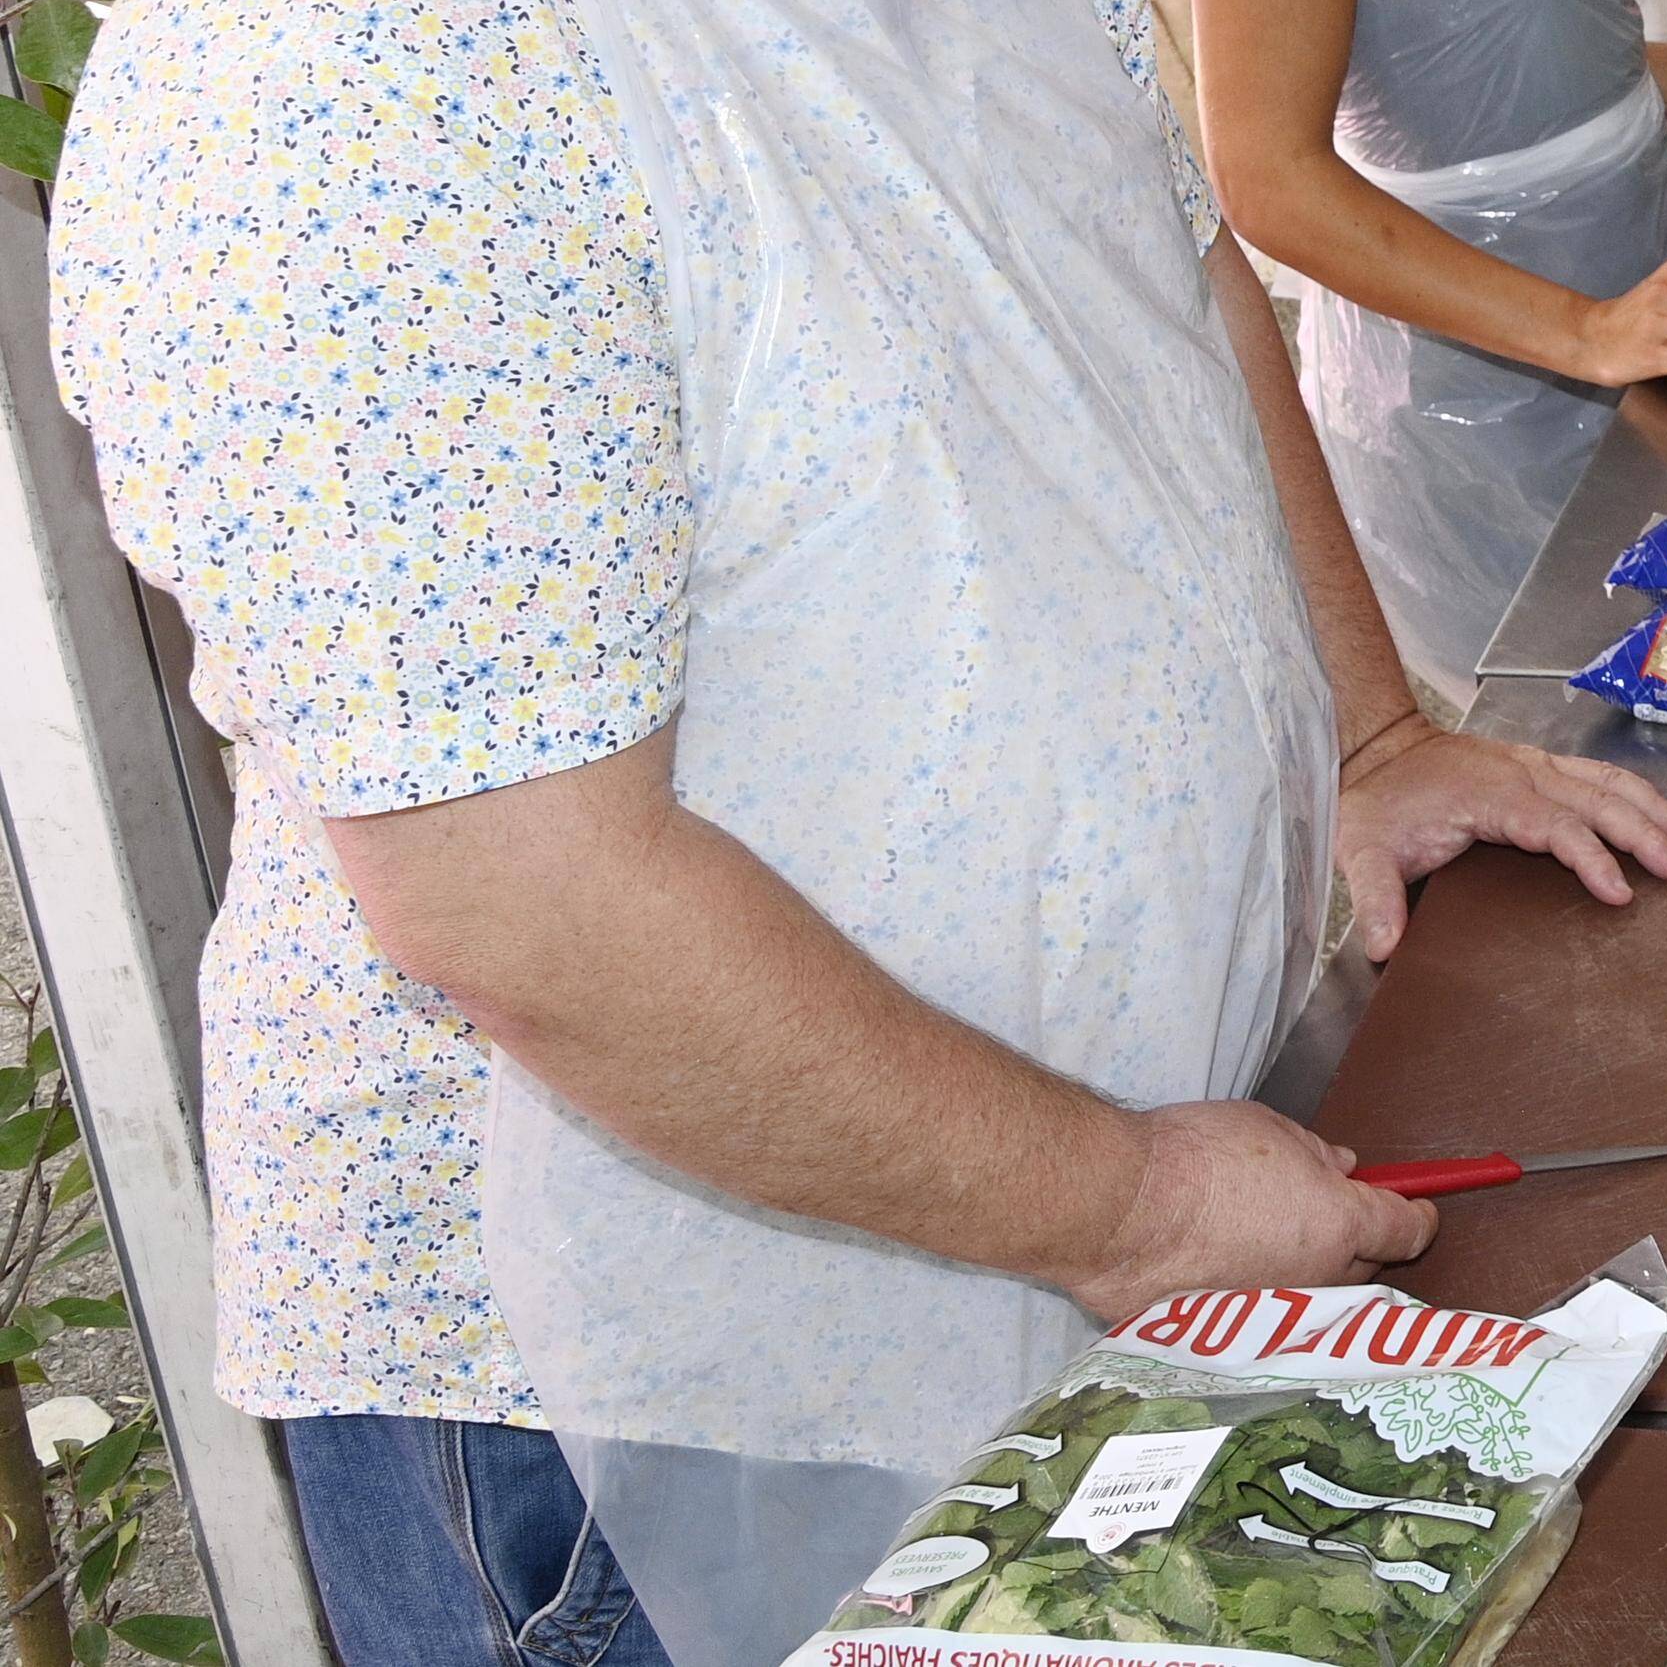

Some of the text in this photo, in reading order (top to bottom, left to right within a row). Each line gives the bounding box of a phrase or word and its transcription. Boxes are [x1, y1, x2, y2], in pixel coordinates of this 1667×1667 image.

[1288, 1467, 1358, 1505] simplement
[1089, 1499, 1160, 1518] MENTHE
[1388, 1565, 1438, 1586] Pratique
[950, 1650, 1158, 1667] MATIQUES
